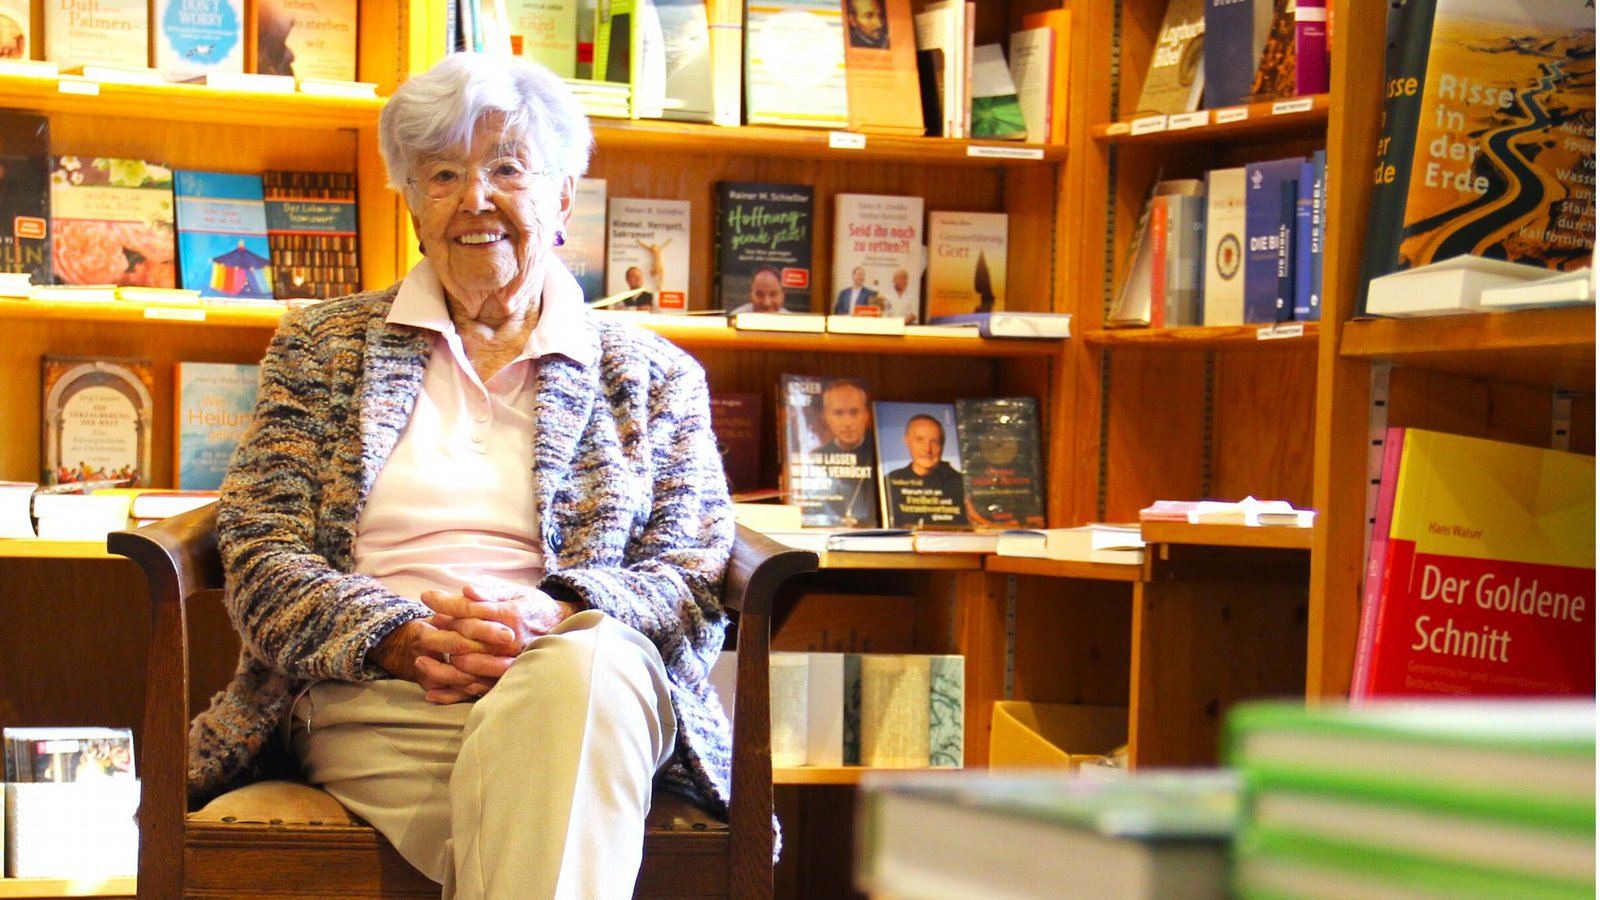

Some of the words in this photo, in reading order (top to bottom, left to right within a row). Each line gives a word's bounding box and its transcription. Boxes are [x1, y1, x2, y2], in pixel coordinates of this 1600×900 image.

[180, 10, 223, 26] WORRY
[306, 18, 349, 32] sterben
[520, 17, 555, 34] Engel
[1438, 73, 1515, 109] Risse
[1435, 104, 1465, 130] in
[1559, 121, 1584, 135] Auf
[1430, 135, 1482, 162] der
[1424, 162, 1490, 195] Erde
[729, 190, 757, 200] Rainer
[1312, 180, 1322, 224] BIBEL
[612, 219, 643, 230] Himmel,
[647, 221, 686, 232] Herrgott,
[612, 229, 656, 238] Sakrament
[849, 223, 871, 237] Seid
[874, 224, 888, 237] ihr
[891, 225, 916, 239] noch
[732, 227, 770, 250] gerade
[1250, 235, 1267, 251] DIE
[1311, 230, 1319, 253] DIE
[1519, 226, 1595, 249] Kalifornien
[854, 241, 866, 252] zu
[869, 240, 910, 255] retten?!
[938, 244, 970, 258] Gott
[824, 453, 858, 466] LASSEN
[827, 465, 873, 479] VERRÜCKT
[906, 496, 939, 505] Freiheit
[899, 503, 961, 515] Verantwortung
[1429, 521, 1451, 536] Hans
[1452, 523, 1483, 540] Walser
[1420, 564, 1471, 606] Der
[1475, 573, 1587, 622] Goldene
[1411, 615, 1512, 664] Schnitt
[1408, 660, 1469, 678] Geometrische
